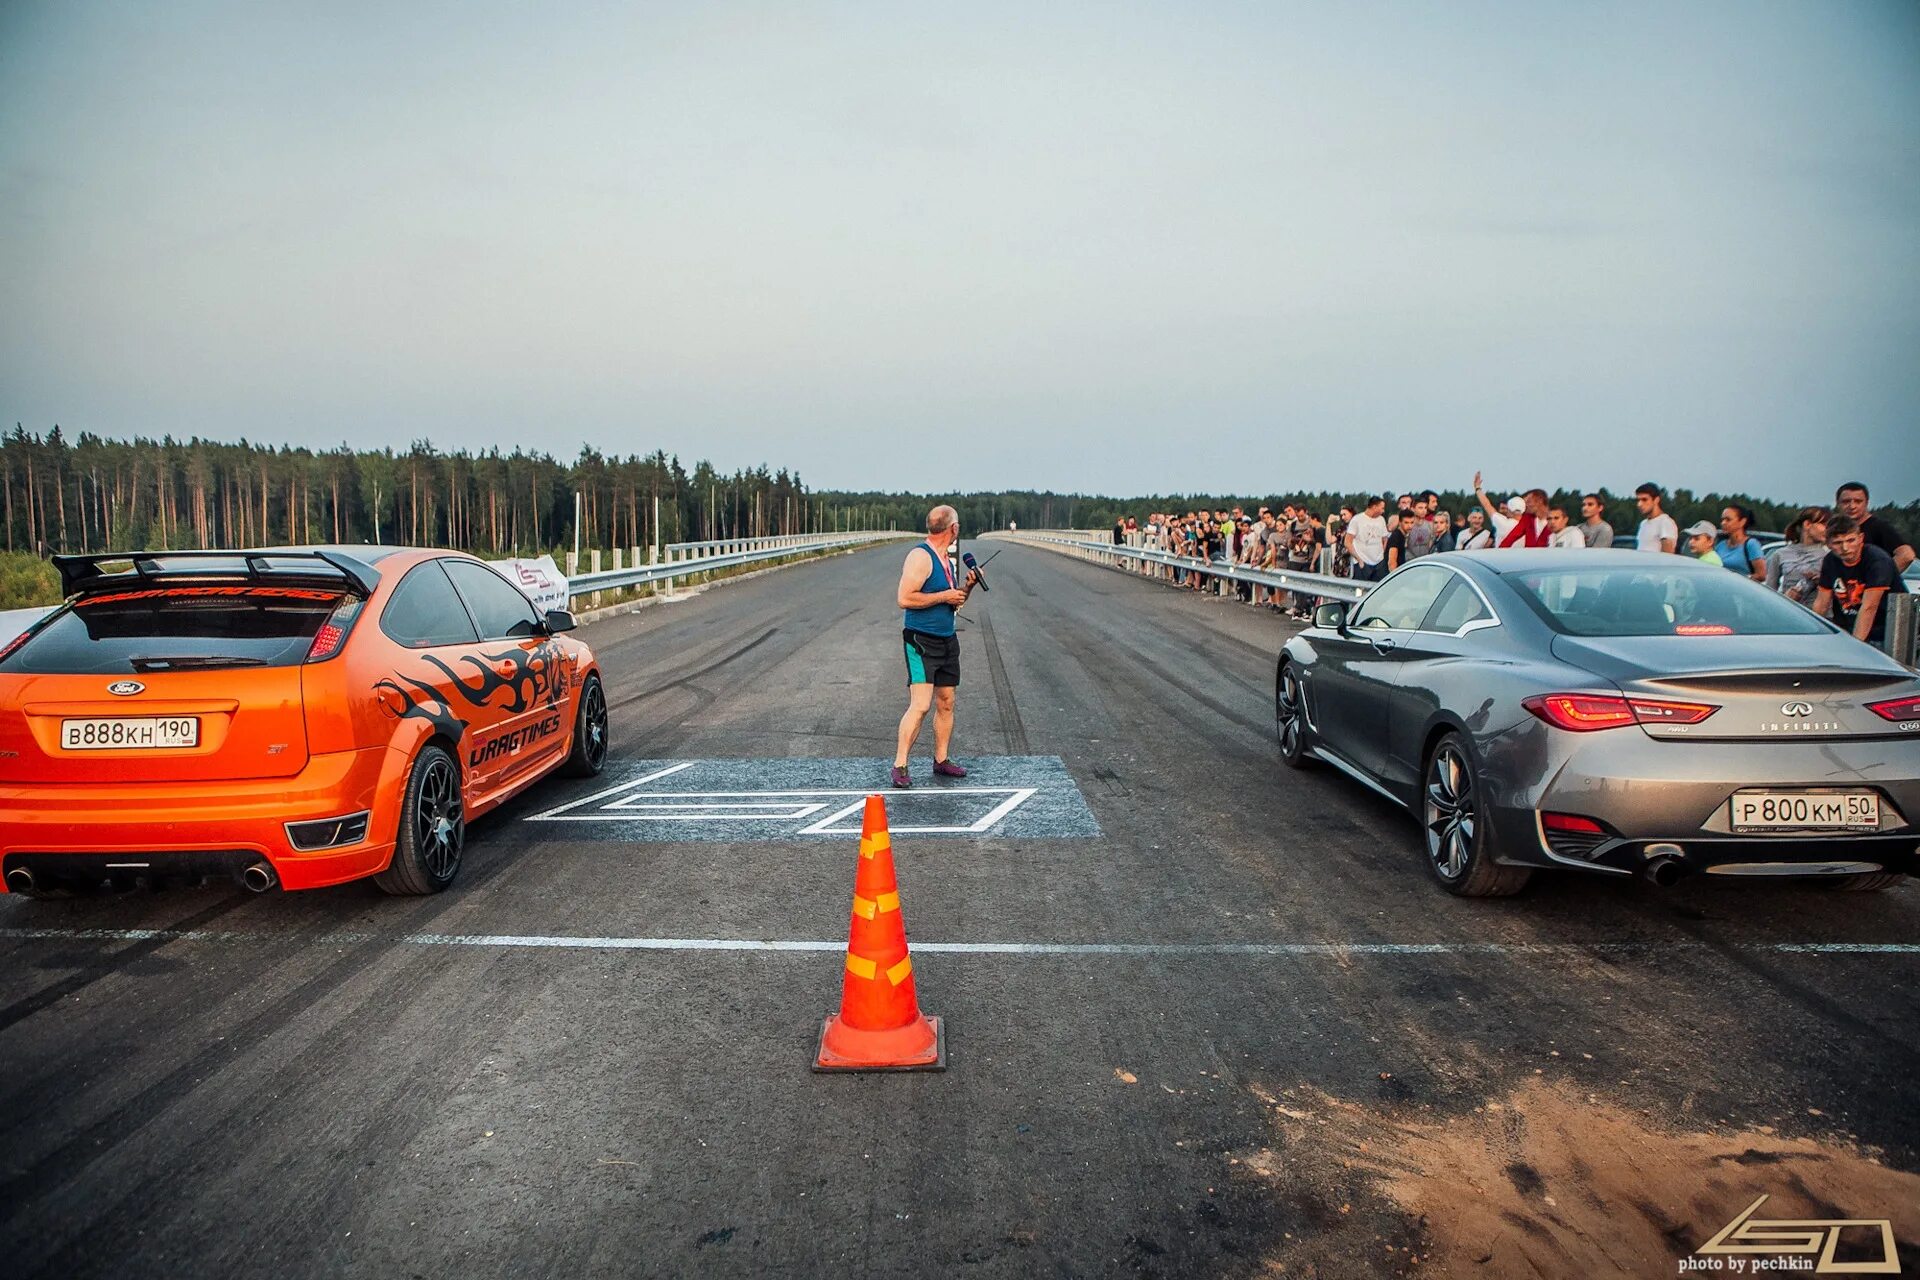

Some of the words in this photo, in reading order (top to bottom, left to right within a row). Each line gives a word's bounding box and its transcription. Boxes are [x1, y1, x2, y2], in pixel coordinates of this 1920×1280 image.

[158, 720, 190, 738] 190
[1760, 722, 1838, 731] INFINITI
[1899, 721, 1920, 731] Q60
[470, 714, 561, 768] DRAGTIMES
[1847, 797, 1870, 815] 50
[1847, 815, 1865, 823] RUS
